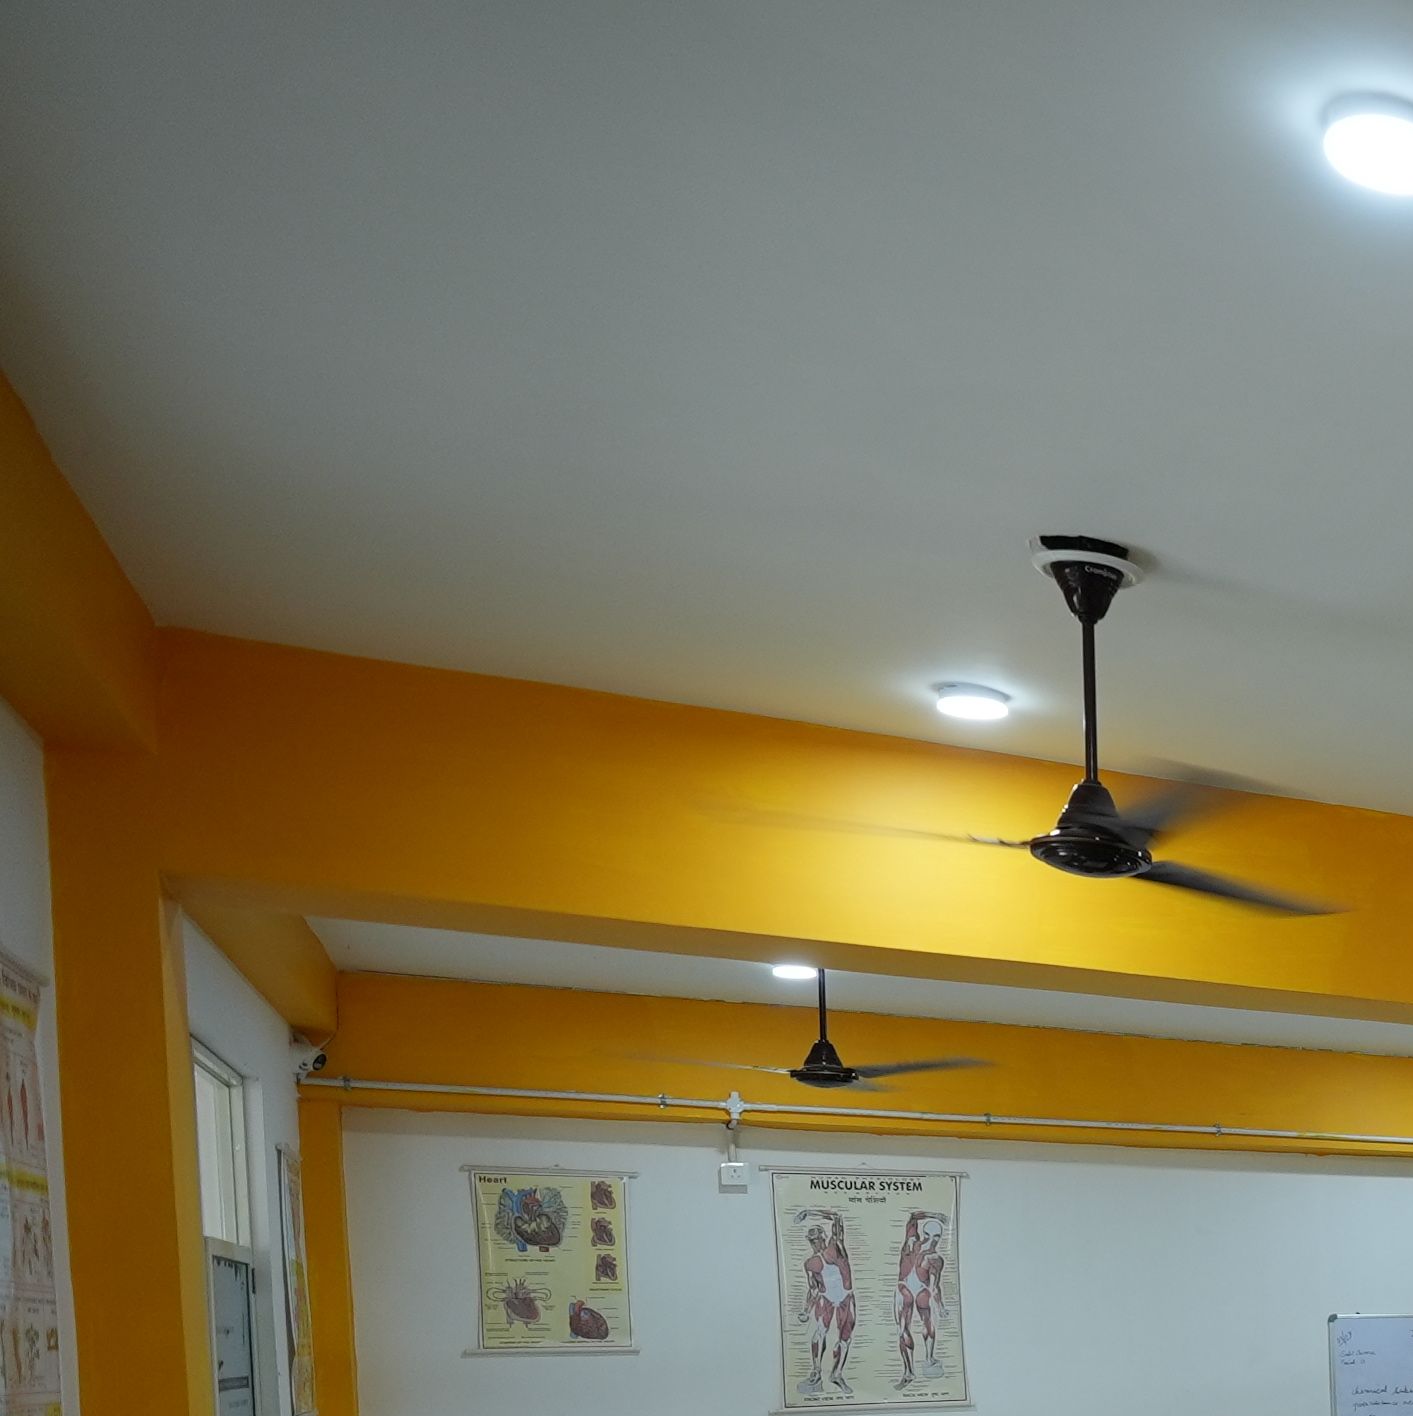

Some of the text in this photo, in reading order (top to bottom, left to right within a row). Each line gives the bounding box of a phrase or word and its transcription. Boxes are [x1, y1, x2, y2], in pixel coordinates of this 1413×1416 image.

[478, 1175, 508, 1185] Heart
[810, 1179, 923, 1192] MUSCULAR SYSTEM
